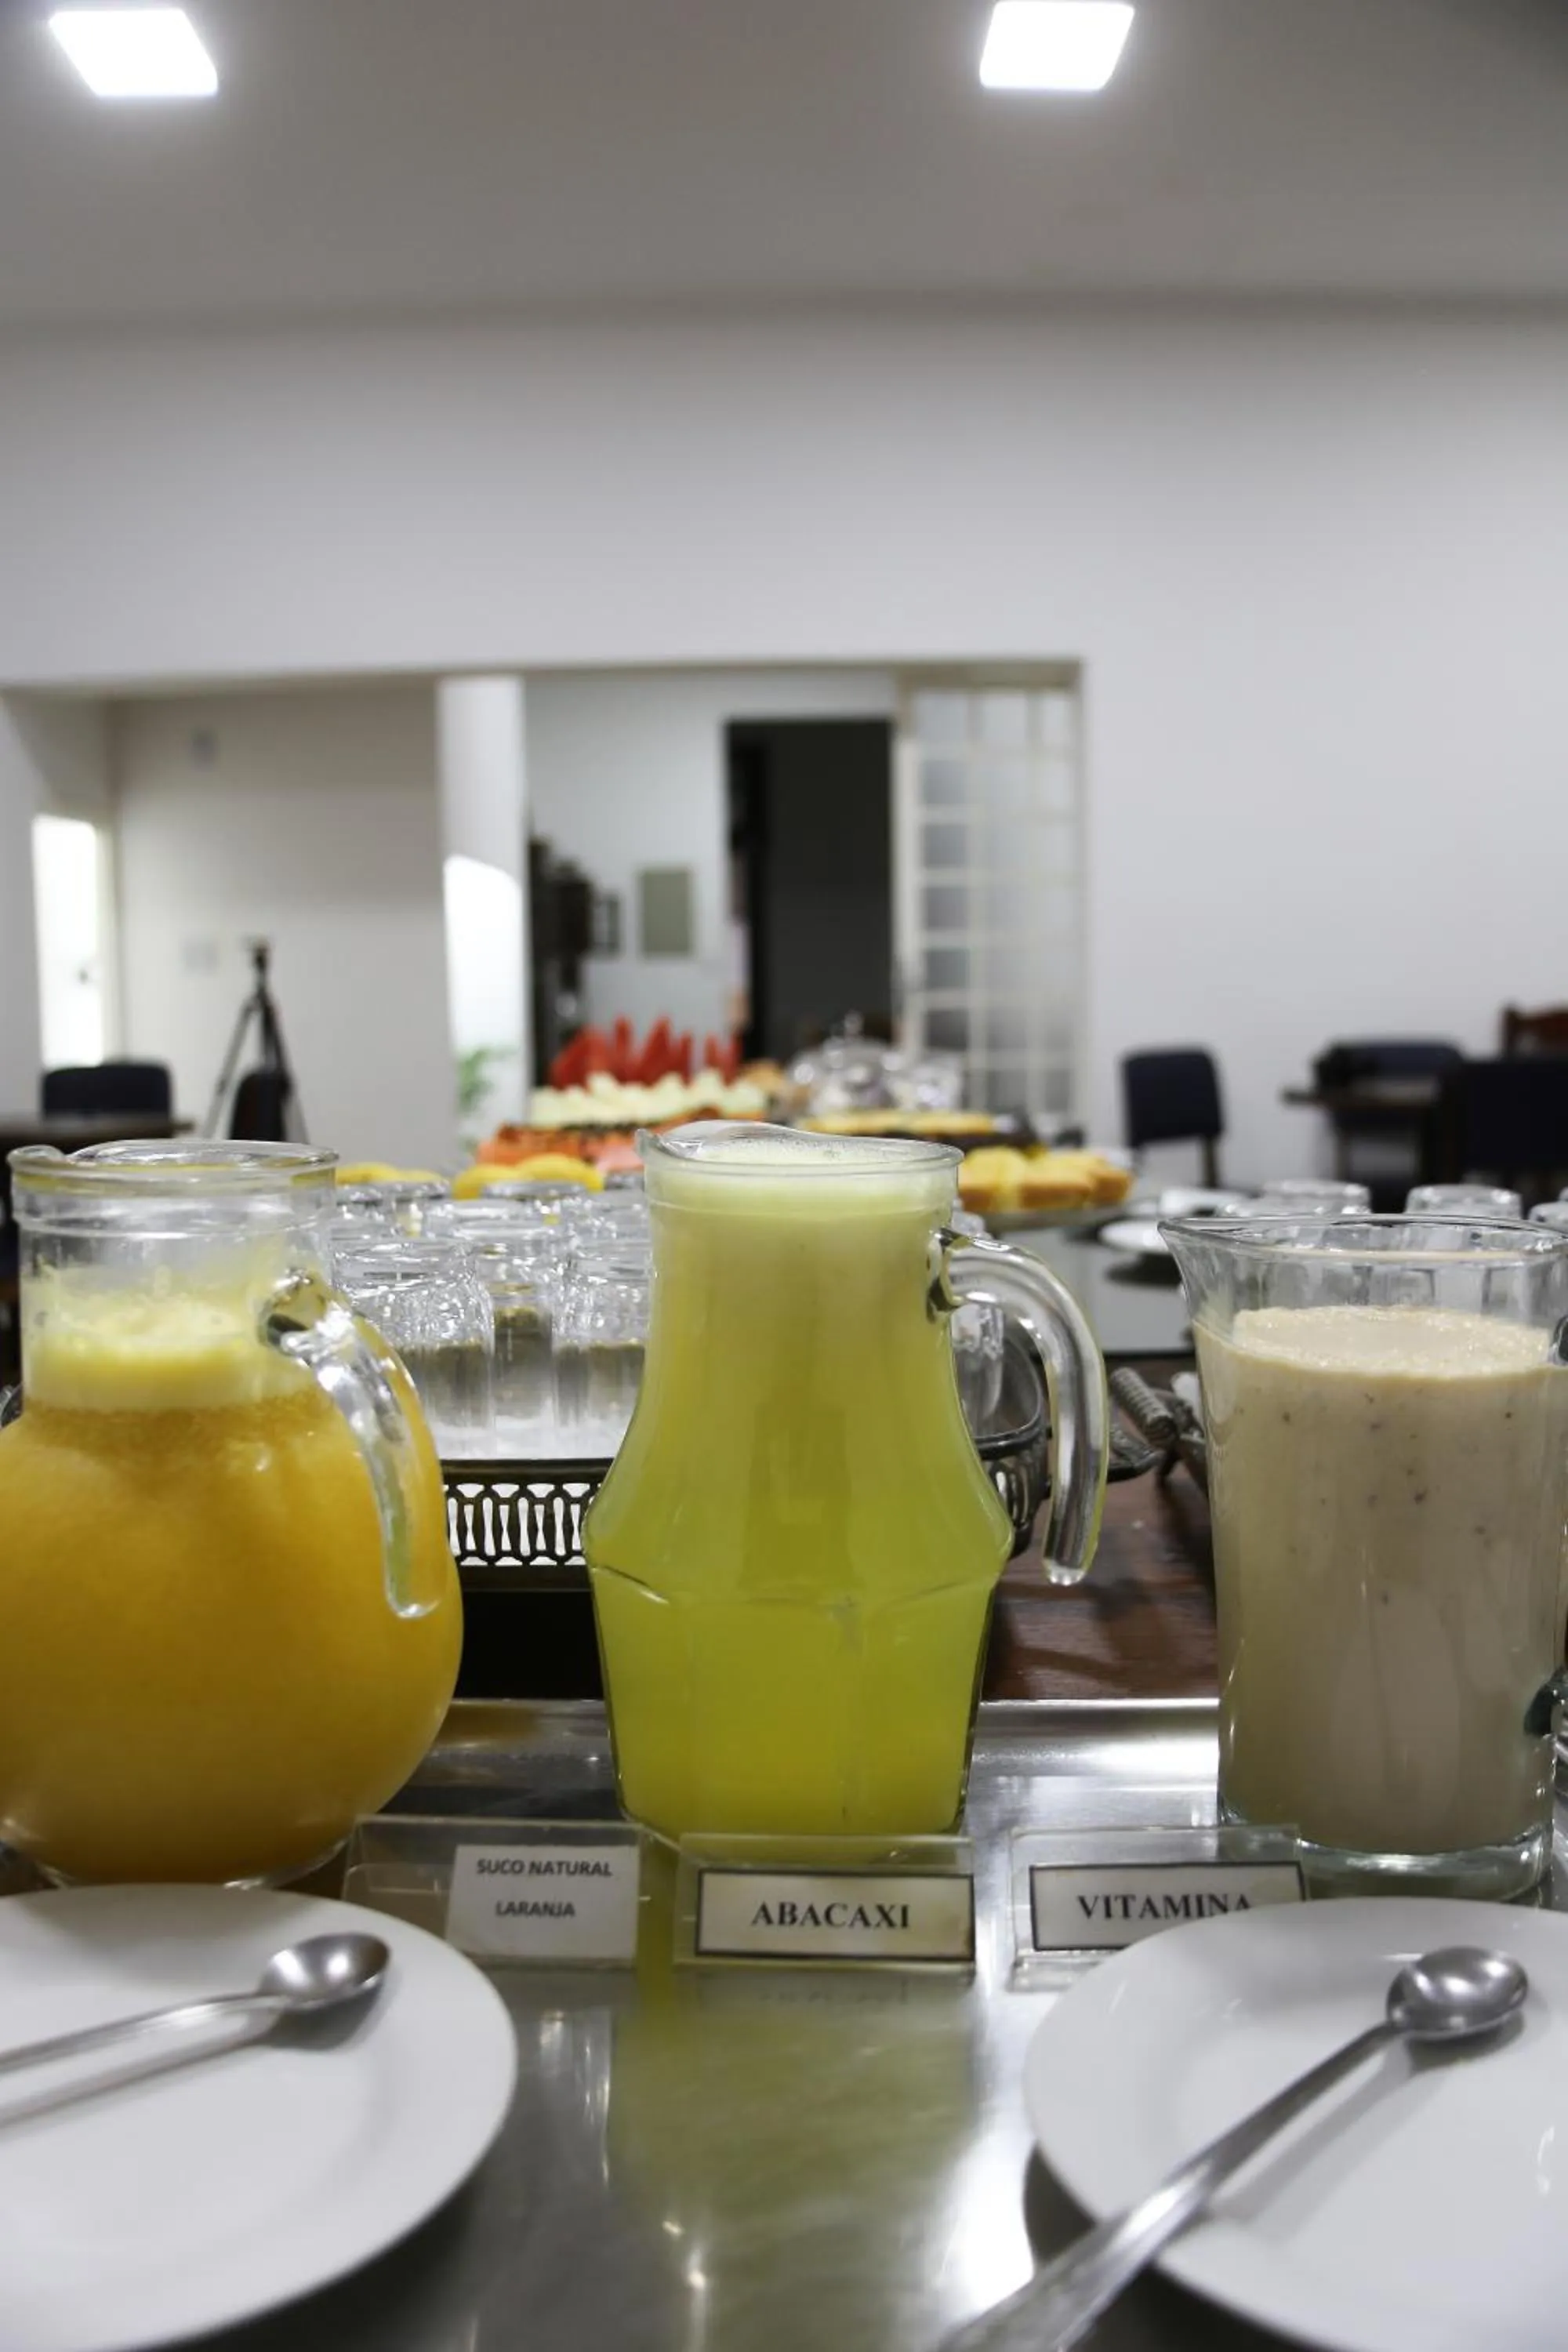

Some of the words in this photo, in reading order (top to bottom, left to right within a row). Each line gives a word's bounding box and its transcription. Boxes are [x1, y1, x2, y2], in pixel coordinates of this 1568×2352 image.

[477, 1859, 524, 1875] SUCO
[528, 1860, 612, 1877] NATURAL
[495, 1900, 575, 1918] LARANJA
[751, 1901, 909, 1929] ABACAXI
[1076, 1893, 1252, 1920] VITAMINA
